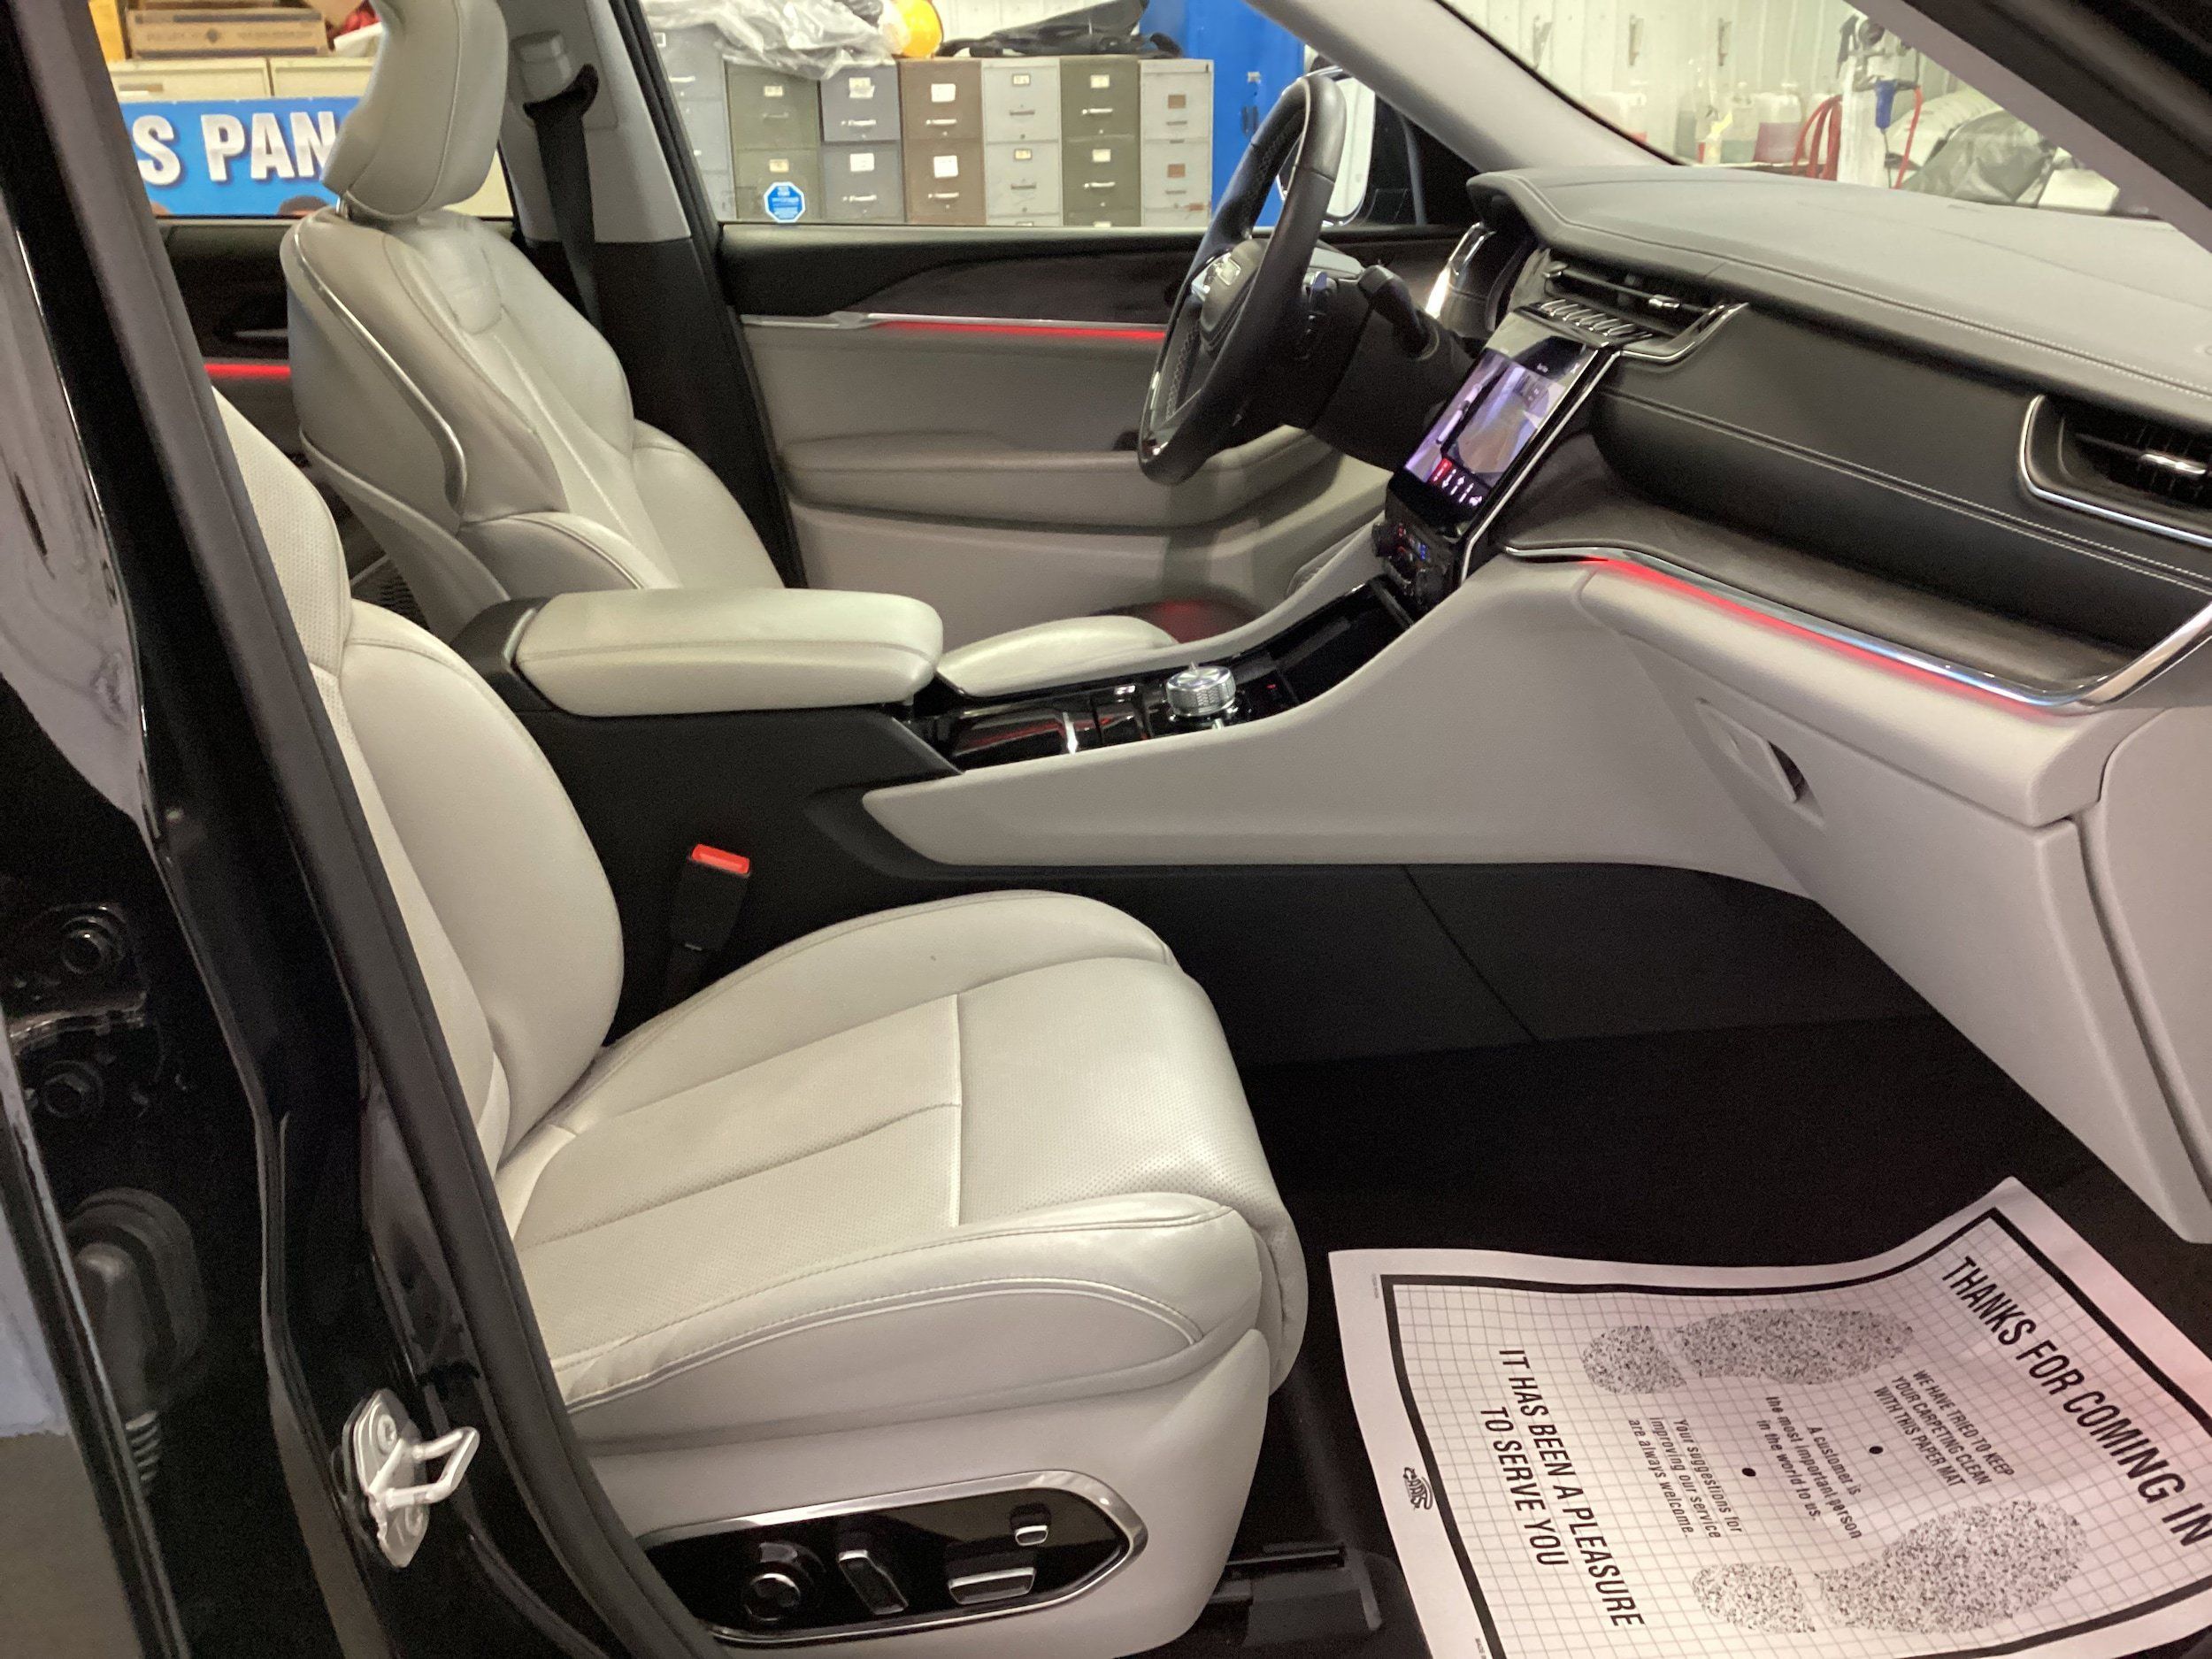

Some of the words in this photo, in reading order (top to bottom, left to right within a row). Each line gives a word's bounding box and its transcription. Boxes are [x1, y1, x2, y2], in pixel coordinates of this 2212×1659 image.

[1499, 1350, 1530, 1369] IT
[1509, 1377, 1548, 1417] HAS
[1941, 1256, 2037, 1346] THANKS
[2016, 1340, 2085, 1395] FOR
[2062, 1390, 2186, 1504] COMING
[2162, 1502, 2212, 1547] IN
[1480, 1407, 1514, 1432] TO
[1528, 1424, 1576, 1476] BEEN
[1807, 1426, 1824, 1435] A
[1814, 1436, 1854, 1485] customer
[1874, 1386, 1902, 1413] WITH
[1894, 1411, 1921, 1436] THIS
[1911, 1434, 1947, 1467] PAPER
[1937, 1464, 1966, 1486] MAT
[1892, 1375, 1921, 1403] YOUR
[1912, 1402, 1965, 1455] CARPETING
[1955, 1453, 1993, 1486] CLEAN
[1913, 1370, 1935, 1386] WE
[1925, 1385, 1955, 1411] HAVE
[1947, 1409, 1979, 1439] TRIED
[1971, 1437, 1992, 1453] TO
[1982, 1452, 2015, 1476] KEEP
[1493, 1440, 1547, 1510] SERVE
[1553, 1486, 1584, 1500] A
[1628, 1419, 1646, 1437] are
[1639, 1440, 1667, 1478] always
[1660, 1481, 1694, 1538] welcome.
[1649, 1417, 1686, 1471] improving
[1678, 1475, 1697, 1494] our
[1689, 1496, 1721, 1538] service
[1673, 1419, 1695, 1443] Your
[1686, 1446, 1732, 1513] suggestions
[1724, 1516, 1742, 1532] for
[1756, 1419, 1771, 1431] in
[1764, 1432, 1783, 1451] the
[1777, 1454, 1807, 1485] world
[1795, 1487, 1811, 1500] to
[1805, 1503, 1822, 1521] us.
[1765, 1396, 1784, 1413] the
[1778, 1416, 1804, 1443] most
[1794, 1444, 1839, 1498] important
[1825, 1498, 1863, 1540] person
[1847, 1483, 1862, 1495] is
[1524, 1518, 1569, 1565] YOU
[1562, 1507, 1645, 1626] PLEASURE
